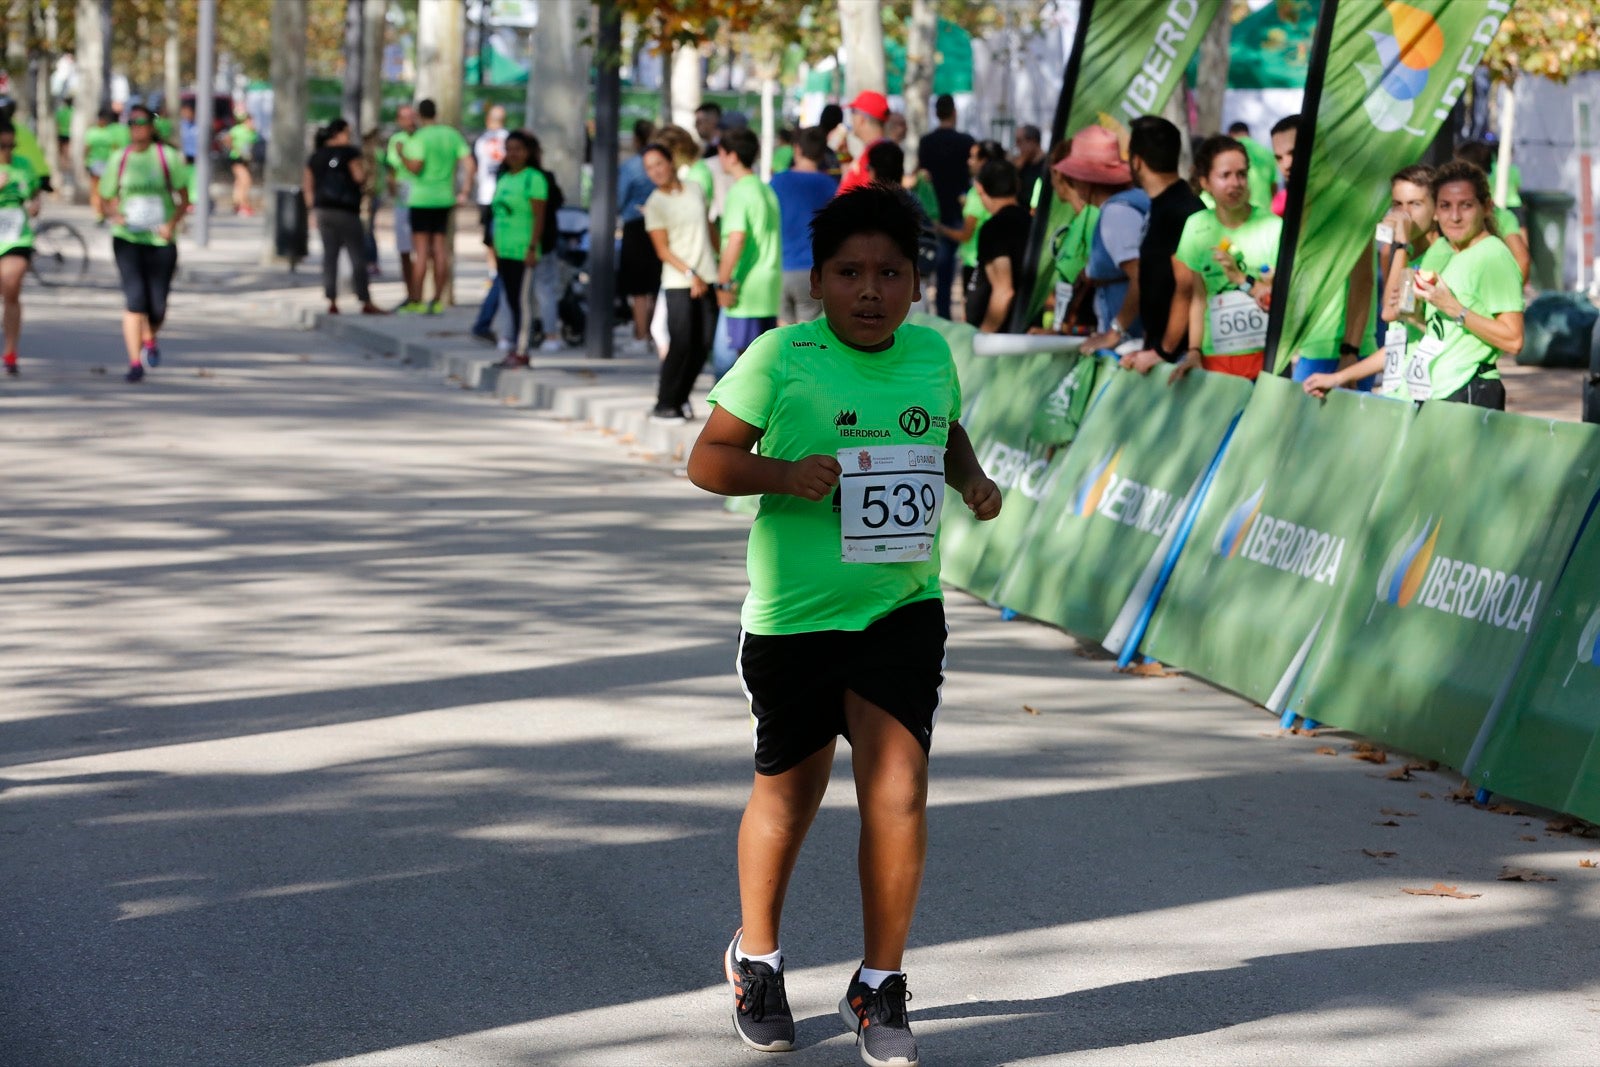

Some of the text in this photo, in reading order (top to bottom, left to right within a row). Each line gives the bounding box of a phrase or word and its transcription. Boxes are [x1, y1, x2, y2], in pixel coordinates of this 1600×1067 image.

[1219, 308, 1263, 335] 566
[840, 428, 892, 439] IBERDROLA
[861, 483, 936, 529] 539
[1240, 511, 1346, 587] IBERDROLA
[1416, 555, 1543, 634] IBERDROLA
